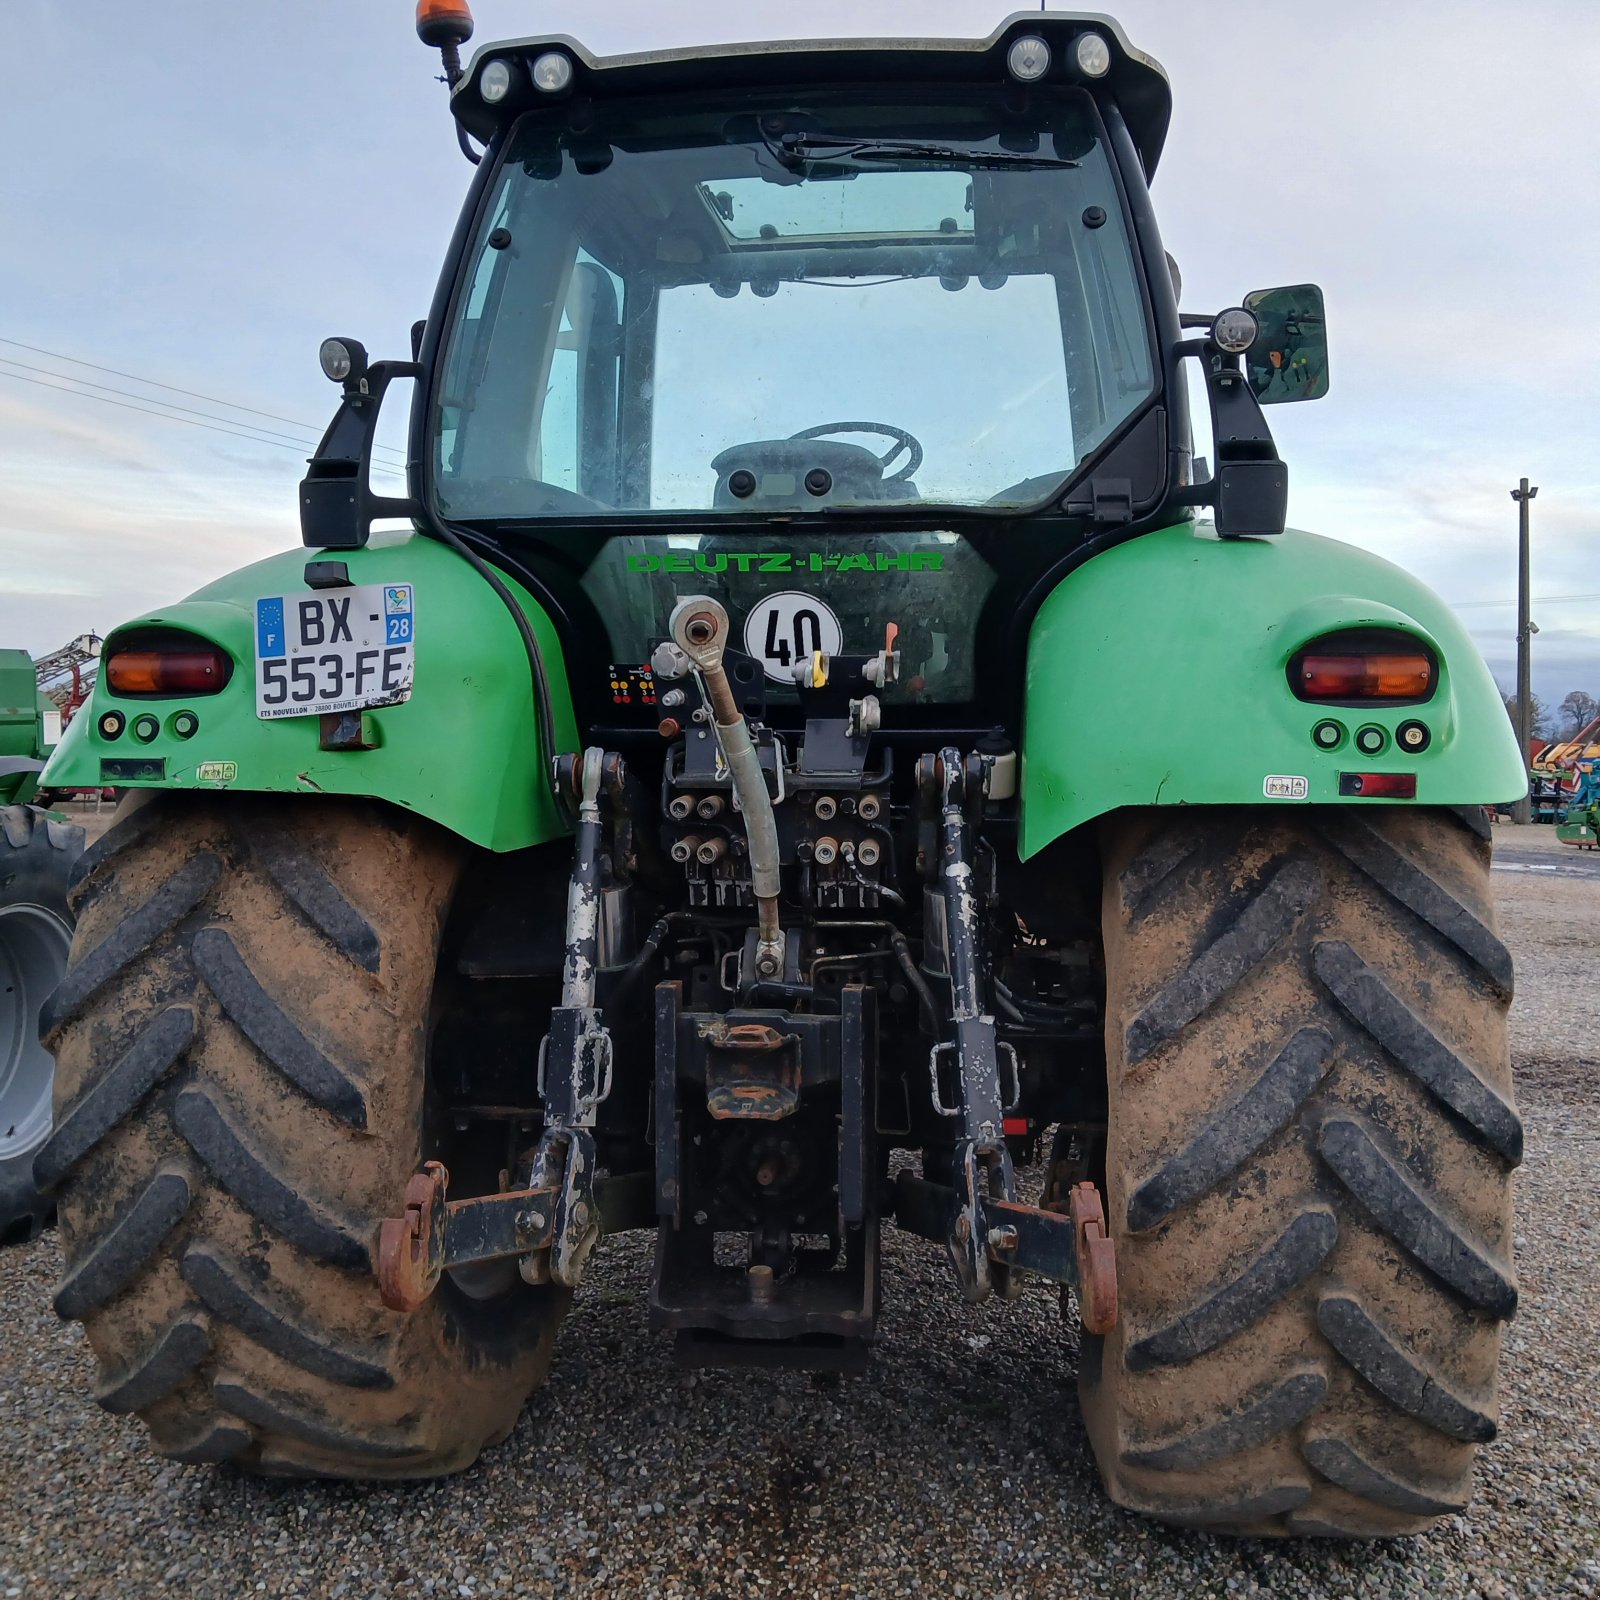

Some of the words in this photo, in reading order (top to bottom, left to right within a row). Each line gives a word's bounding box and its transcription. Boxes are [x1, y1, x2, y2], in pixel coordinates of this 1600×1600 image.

[626, 552, 944, 573] DEUTZ-FAHR
[298, 597, 353, 646] BX
[389, 618, 409, 639] 28
[267, 634, 276, 647] F
[764, 609, 822, 667] 40
[263, 646, 407, 704] 553-FE
[272, 707, 308, 716] NOUVELLON
